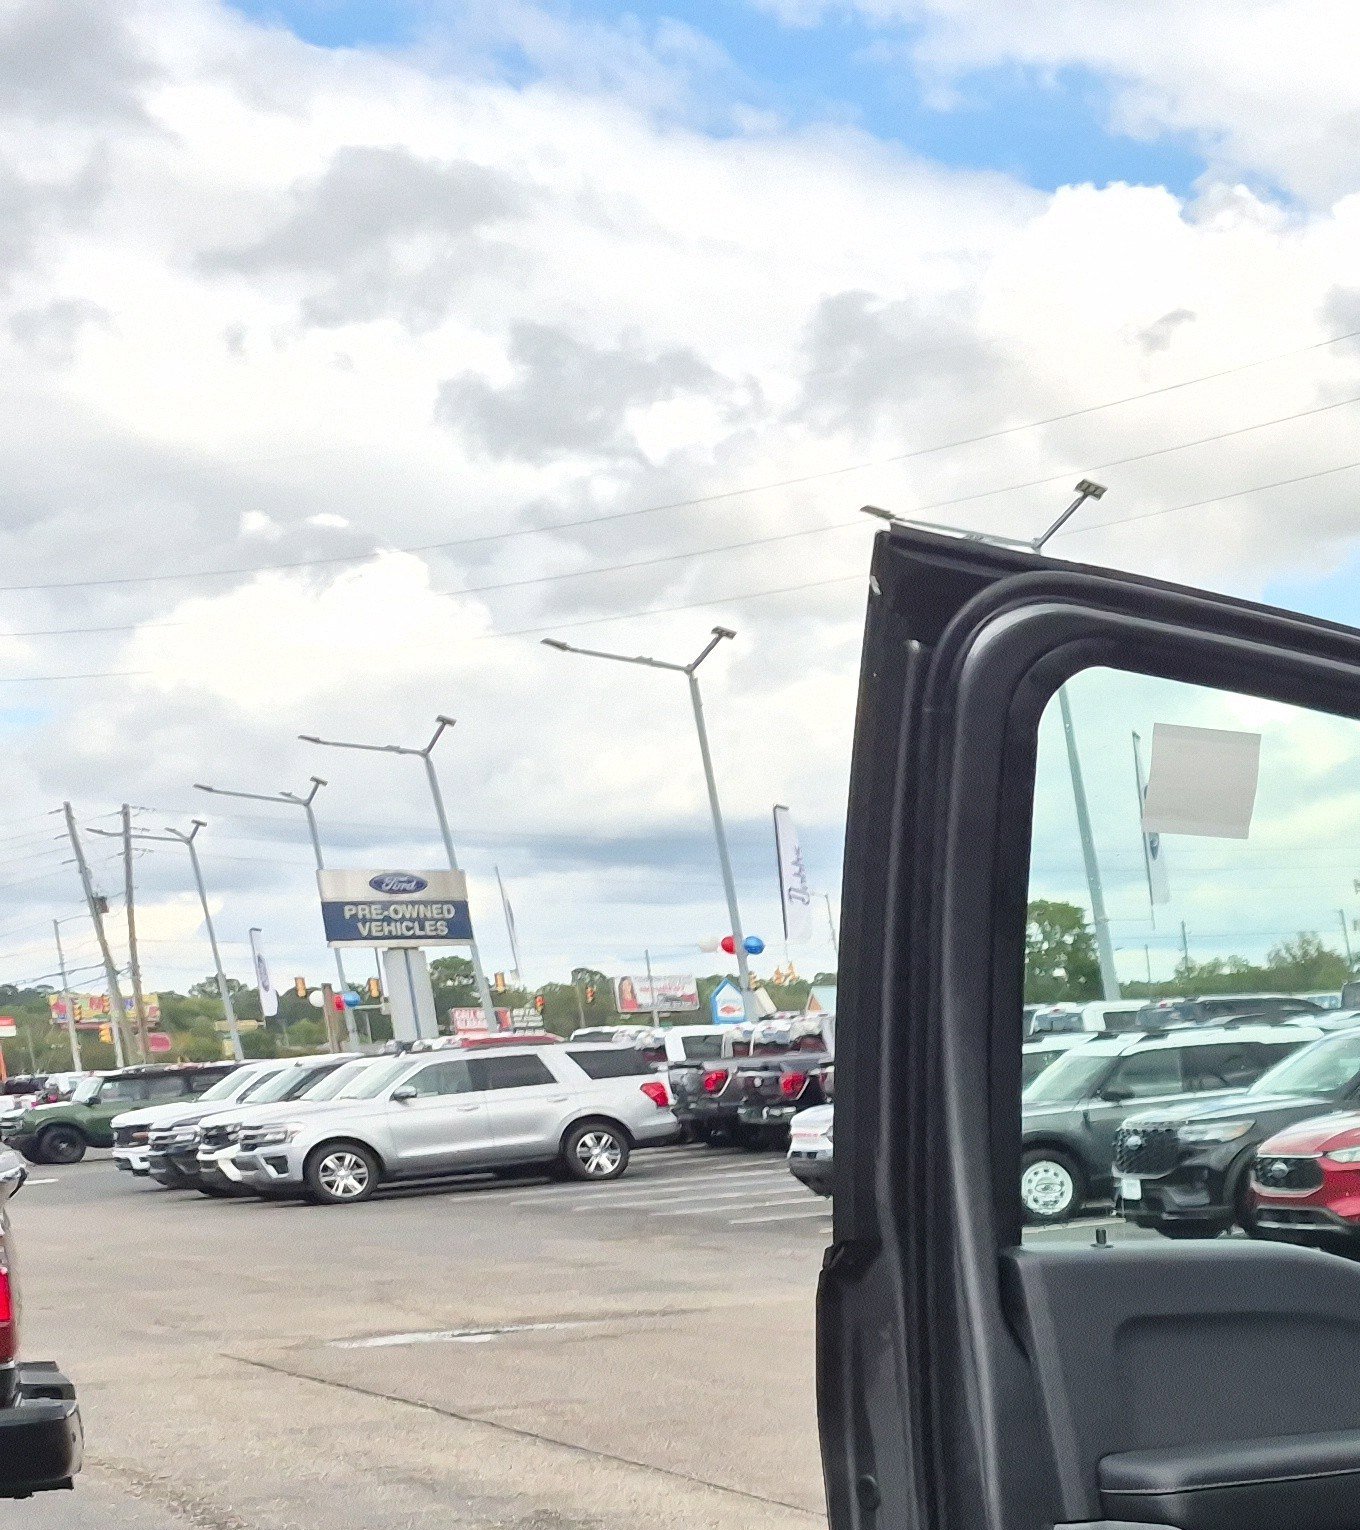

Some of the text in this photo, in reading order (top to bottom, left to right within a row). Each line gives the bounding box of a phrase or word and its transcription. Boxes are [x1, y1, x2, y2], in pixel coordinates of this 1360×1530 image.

[381, 875, 416, 891] Ford
[343, 904, 456, 920] PRE-OWNED
[356, 921, 449, 936] VEHICLES
